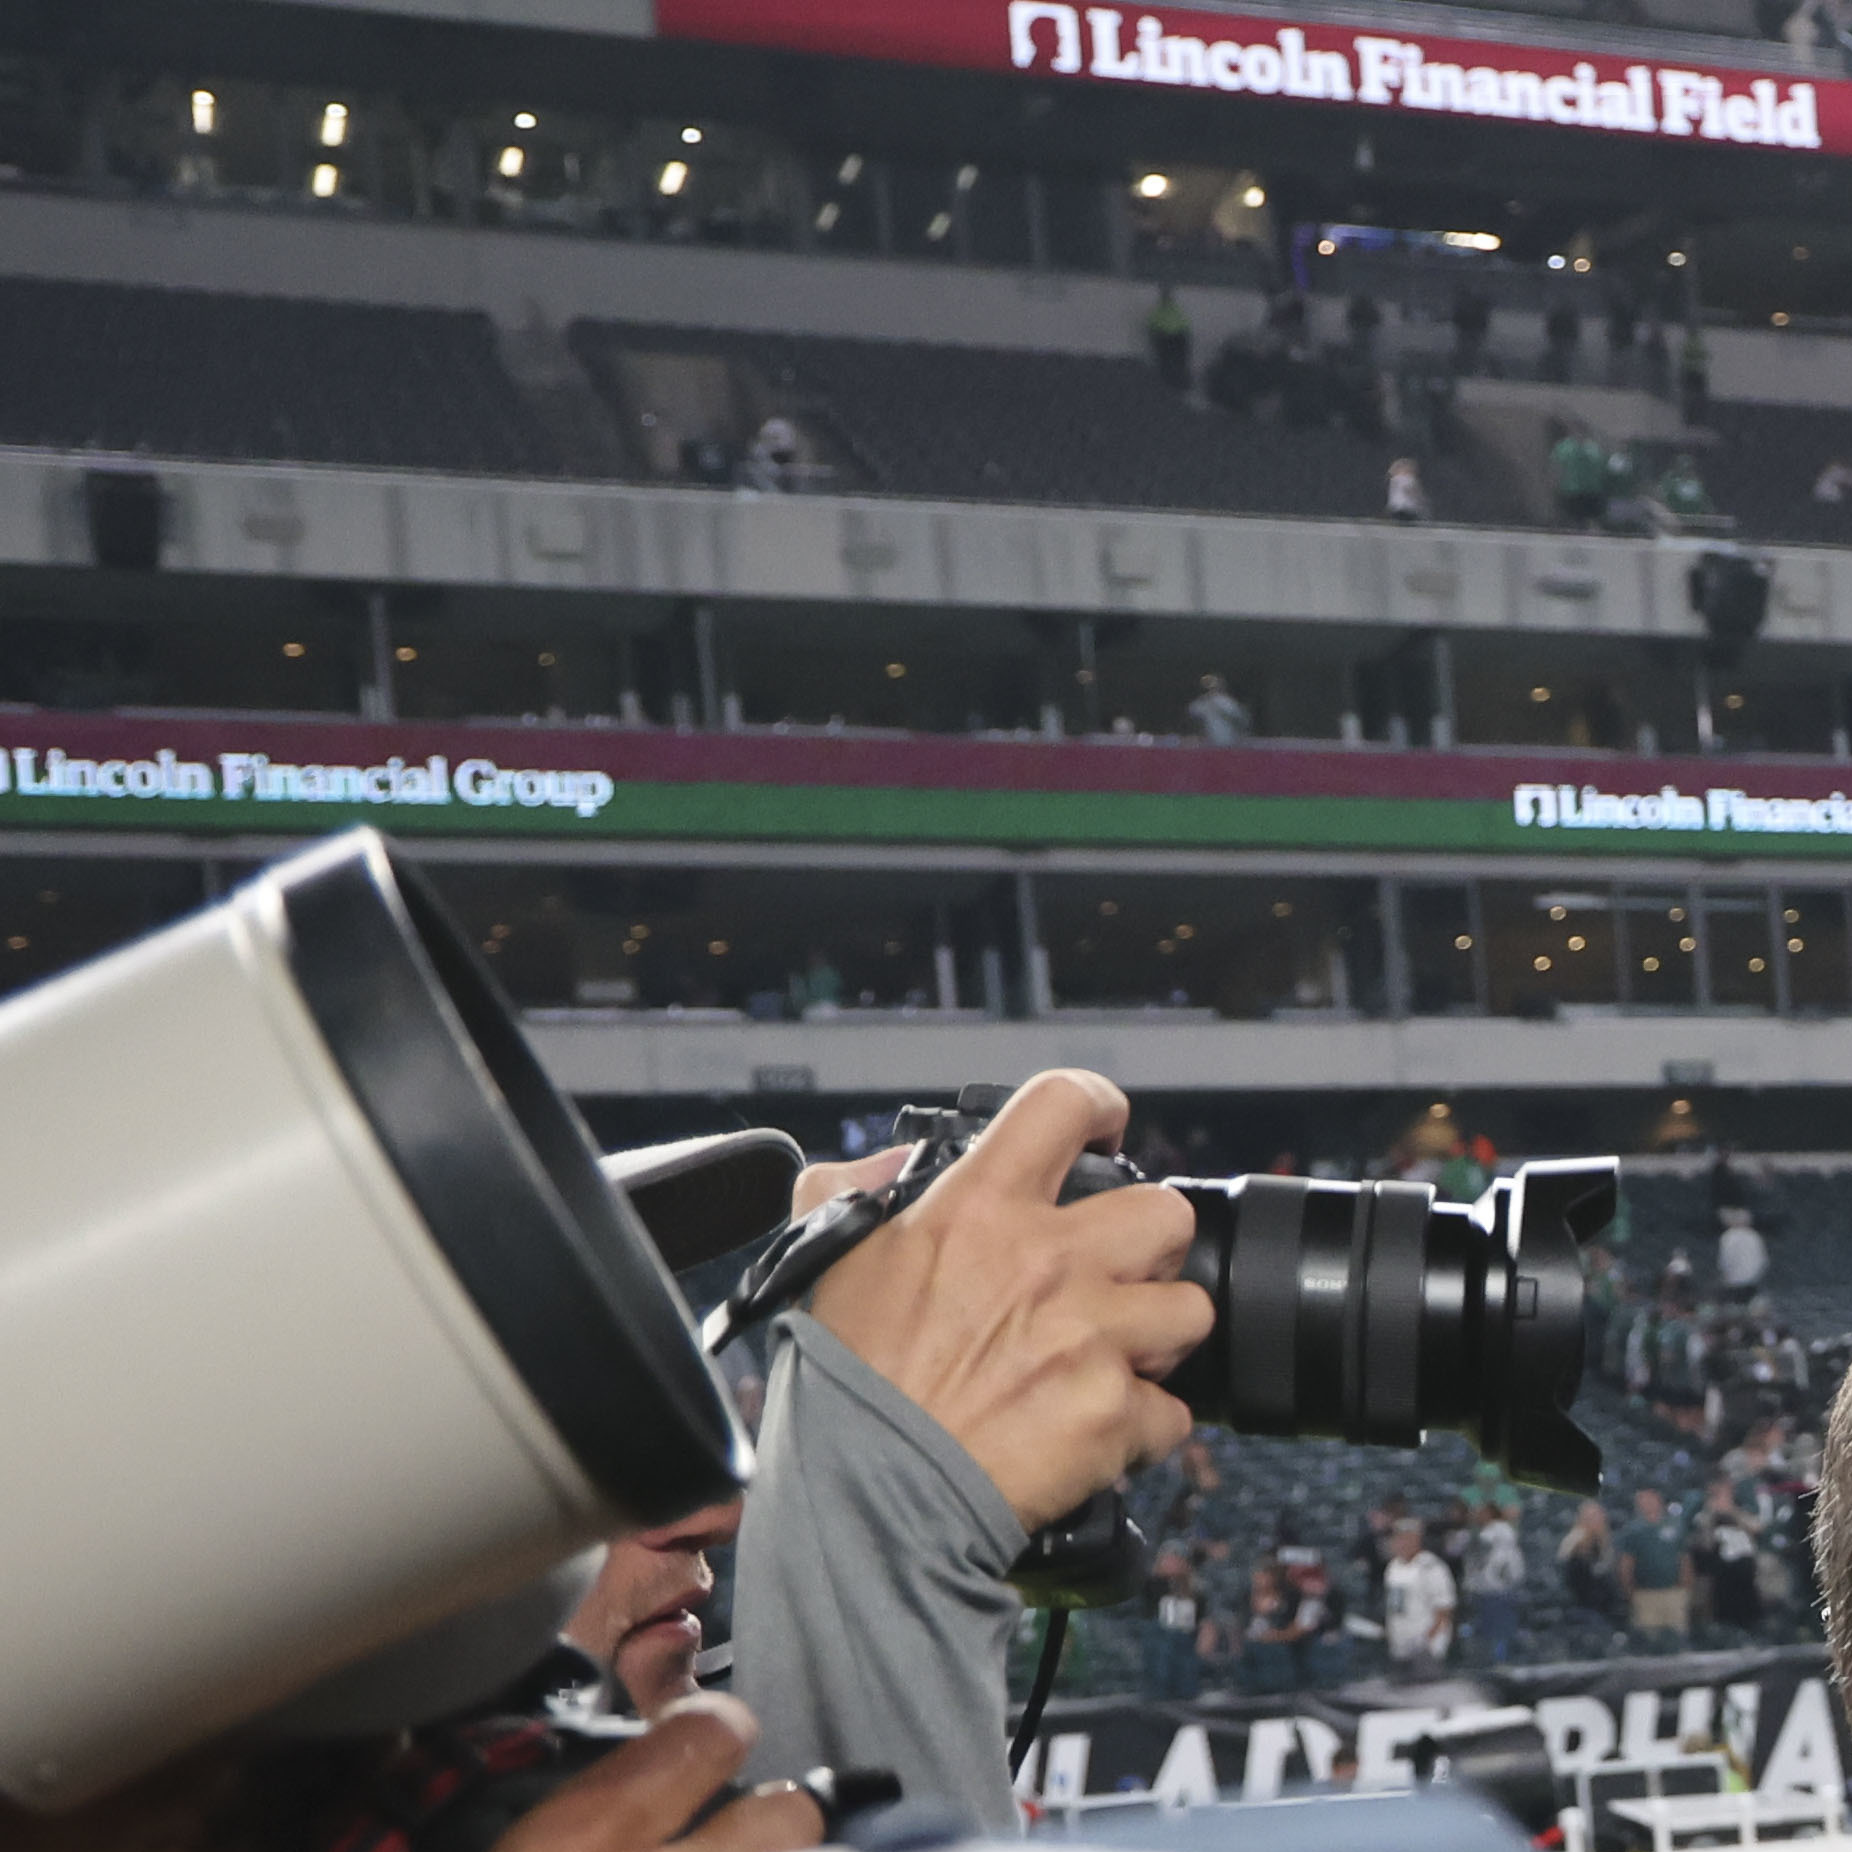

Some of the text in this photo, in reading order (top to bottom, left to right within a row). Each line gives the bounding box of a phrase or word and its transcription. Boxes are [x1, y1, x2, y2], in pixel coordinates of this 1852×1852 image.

[1087, 7, 1822, 149] Lincoln Financial Field
[12, 748, 615, 818] Lincoln Financial Group
[1557, 784, 1705, 831] Lincoln
